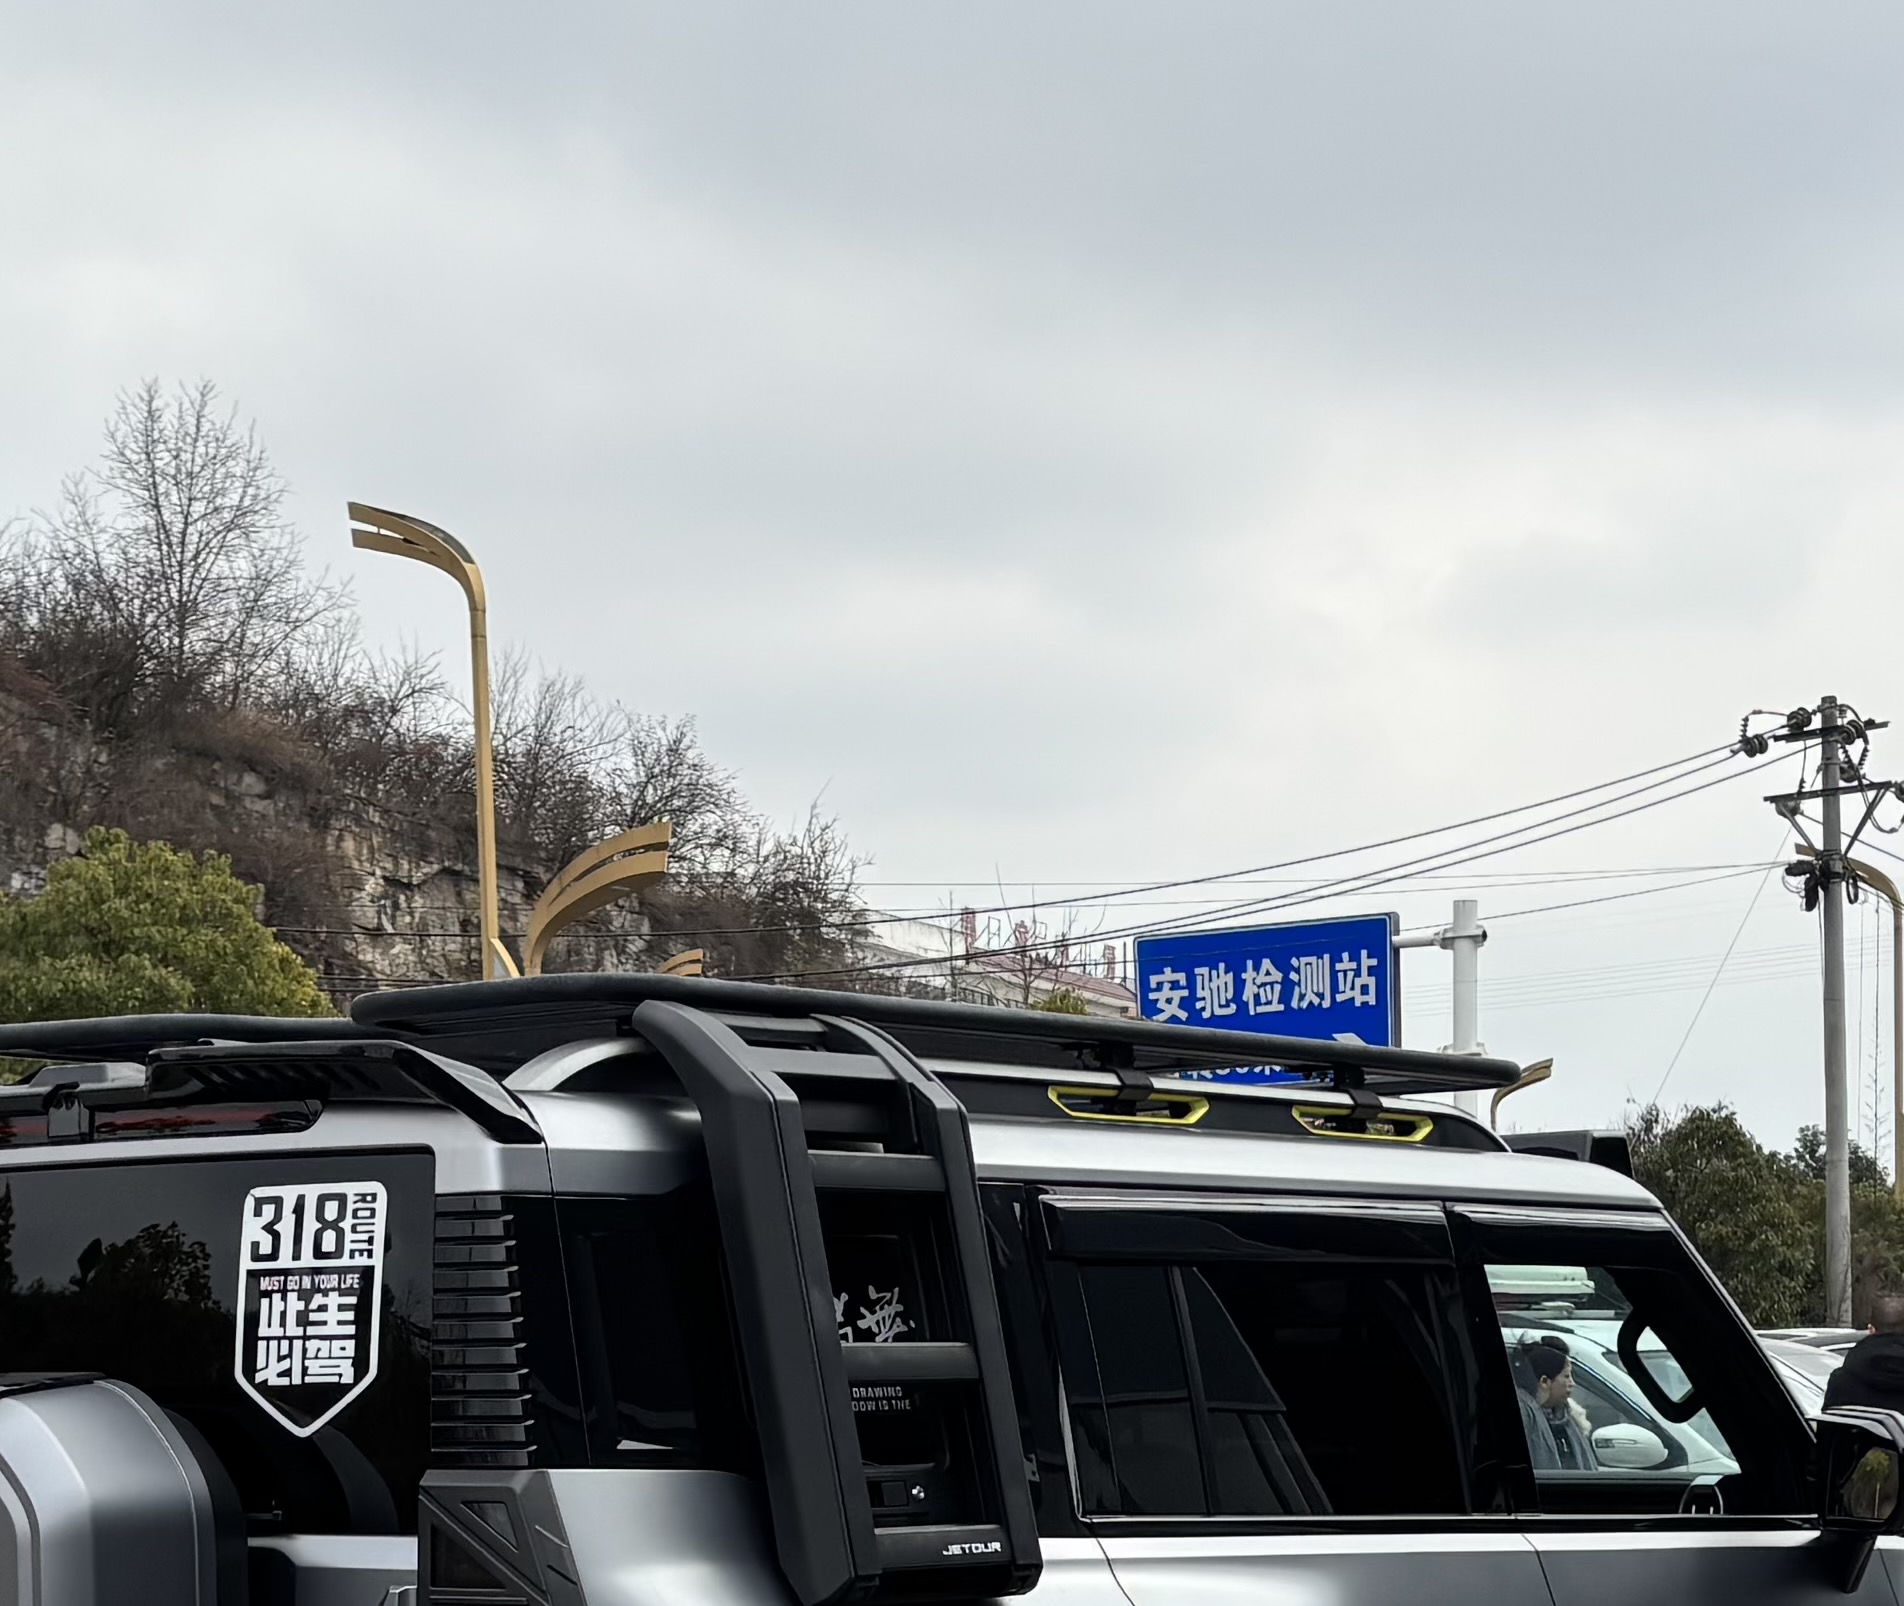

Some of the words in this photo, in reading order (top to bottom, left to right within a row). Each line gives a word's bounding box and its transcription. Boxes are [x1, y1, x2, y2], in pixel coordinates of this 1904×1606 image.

[1149, 949, 1378, 1022] 安驰检测站
[251, 1193, 348, 1262] 318
[349, 1192, 378, 1260] ROUTE
[260, 1276, 285, 1291] MUST
[287, 1275, 300, 1290] GO
[302, 1275, 312, 1289] IN
[313, 1275, 339, 1289] YOUR
[340, 1274, 360, 1288] LIFE
[258, 1291, 357, 1337] 此生
[255, 1339, 356, 1386] 必驾
[852, 1386, 903, 1399] DRAWING
[943, 1541, 1001, 1555] JETOUR
